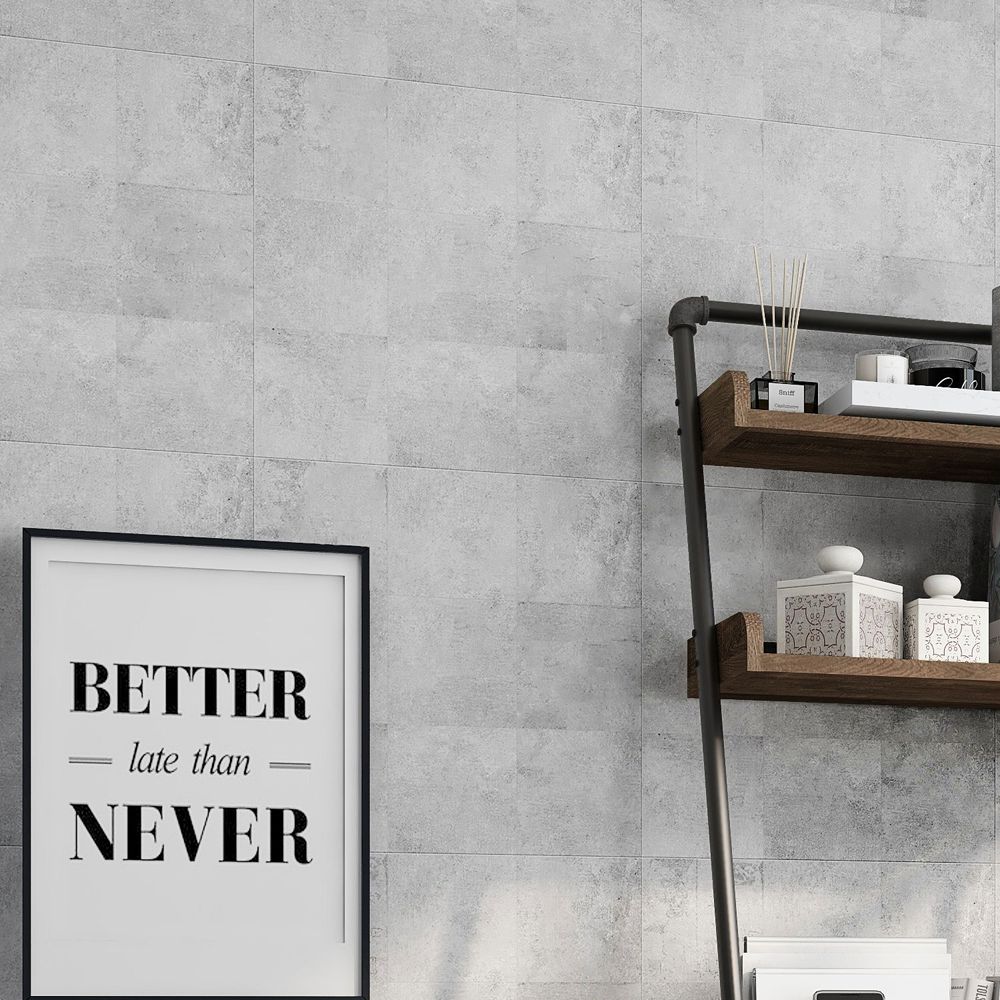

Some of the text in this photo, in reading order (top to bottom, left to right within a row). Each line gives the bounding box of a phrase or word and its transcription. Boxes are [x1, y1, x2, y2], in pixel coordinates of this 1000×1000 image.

[69, 661, 312, 720] BETTER
[128, 741, 250, 776] late than
[68, 802, 313, 865] NEVER
